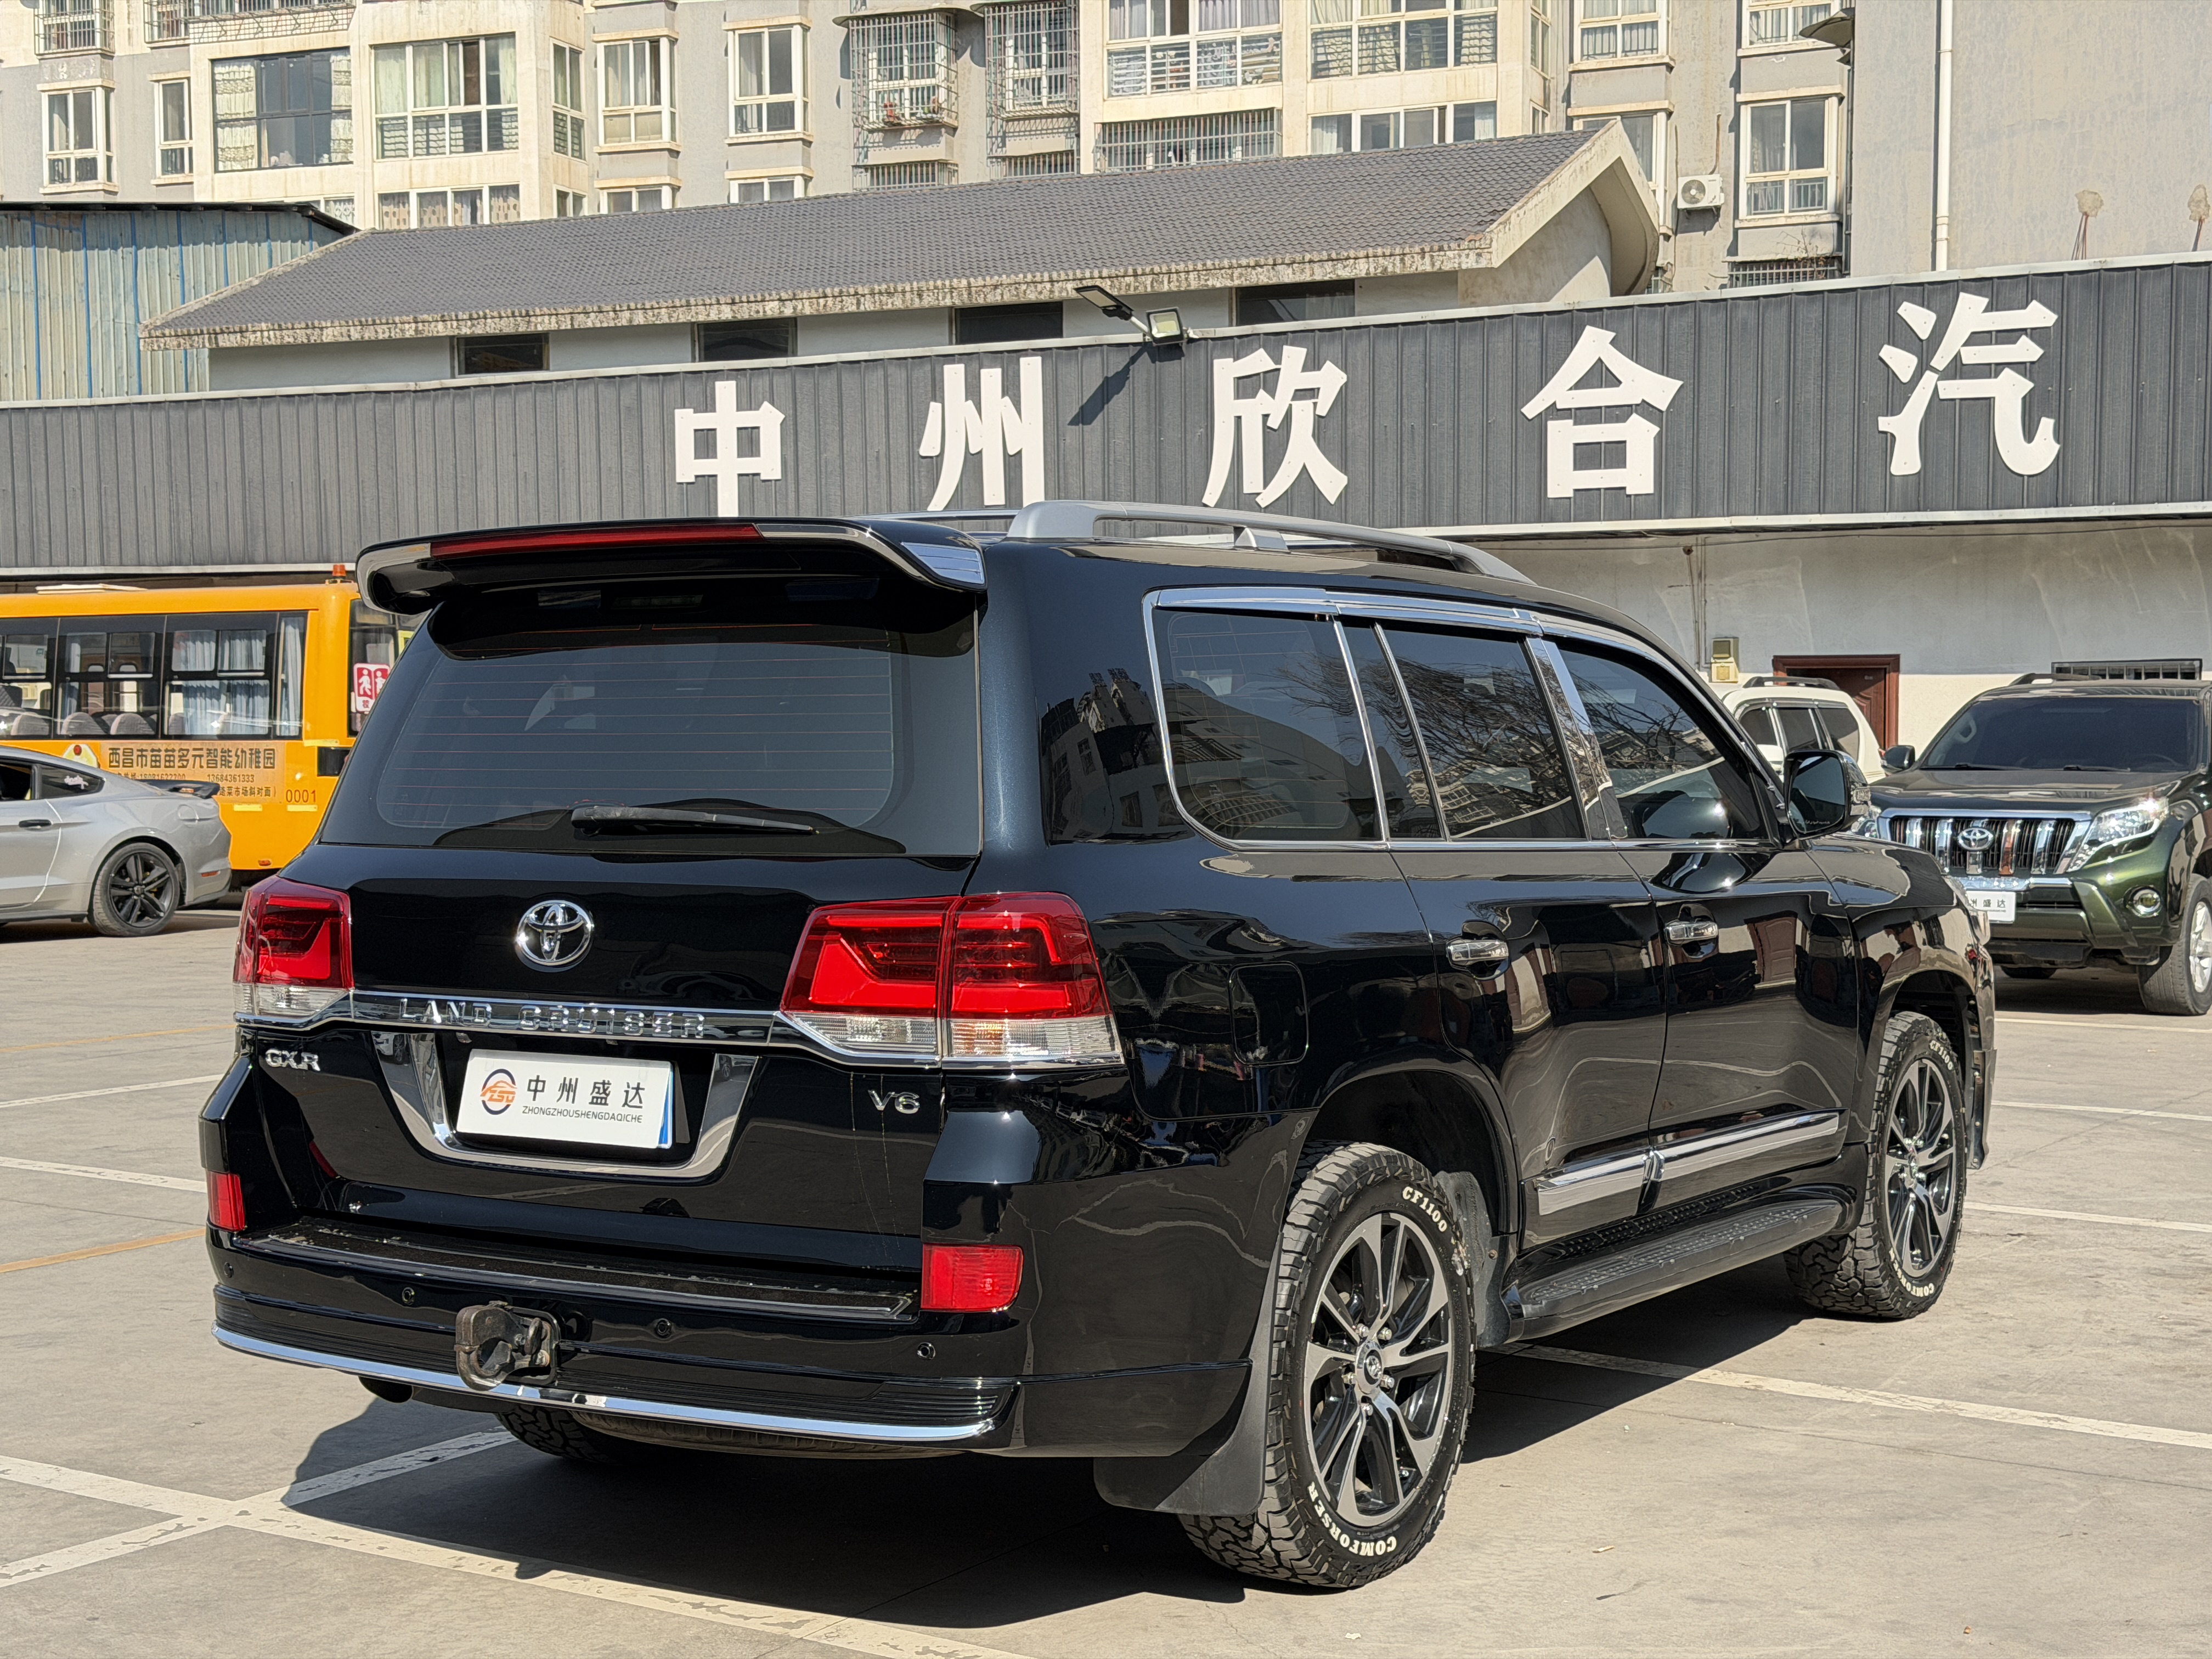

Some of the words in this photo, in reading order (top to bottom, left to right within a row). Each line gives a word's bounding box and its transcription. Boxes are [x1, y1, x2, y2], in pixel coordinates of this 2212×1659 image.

[109, 747, 275, 769] 西昌市苗苗多元智能幼稚园
[207, 774, 255, 783] 13684361333
[286, 789, 317, 803] 0001
[399, 998, 492, 1028] LAND
[519, 1003, 704, 1038] CRUISER
[266, 1047, 321, 1071] GXR
[1929, 1040, 1953, 1070] CF1100
[527, 1075, 646, 1109] 中州盛达
[867, 1089, 921, 1114] V6
[522, 1105, 643, 1124] ZHONGZHOUSHENGDAQICHE
[1402, 1186, 1448, 1232] CF1100
[1308, 1481, 1397, 1556] COMFORSER
